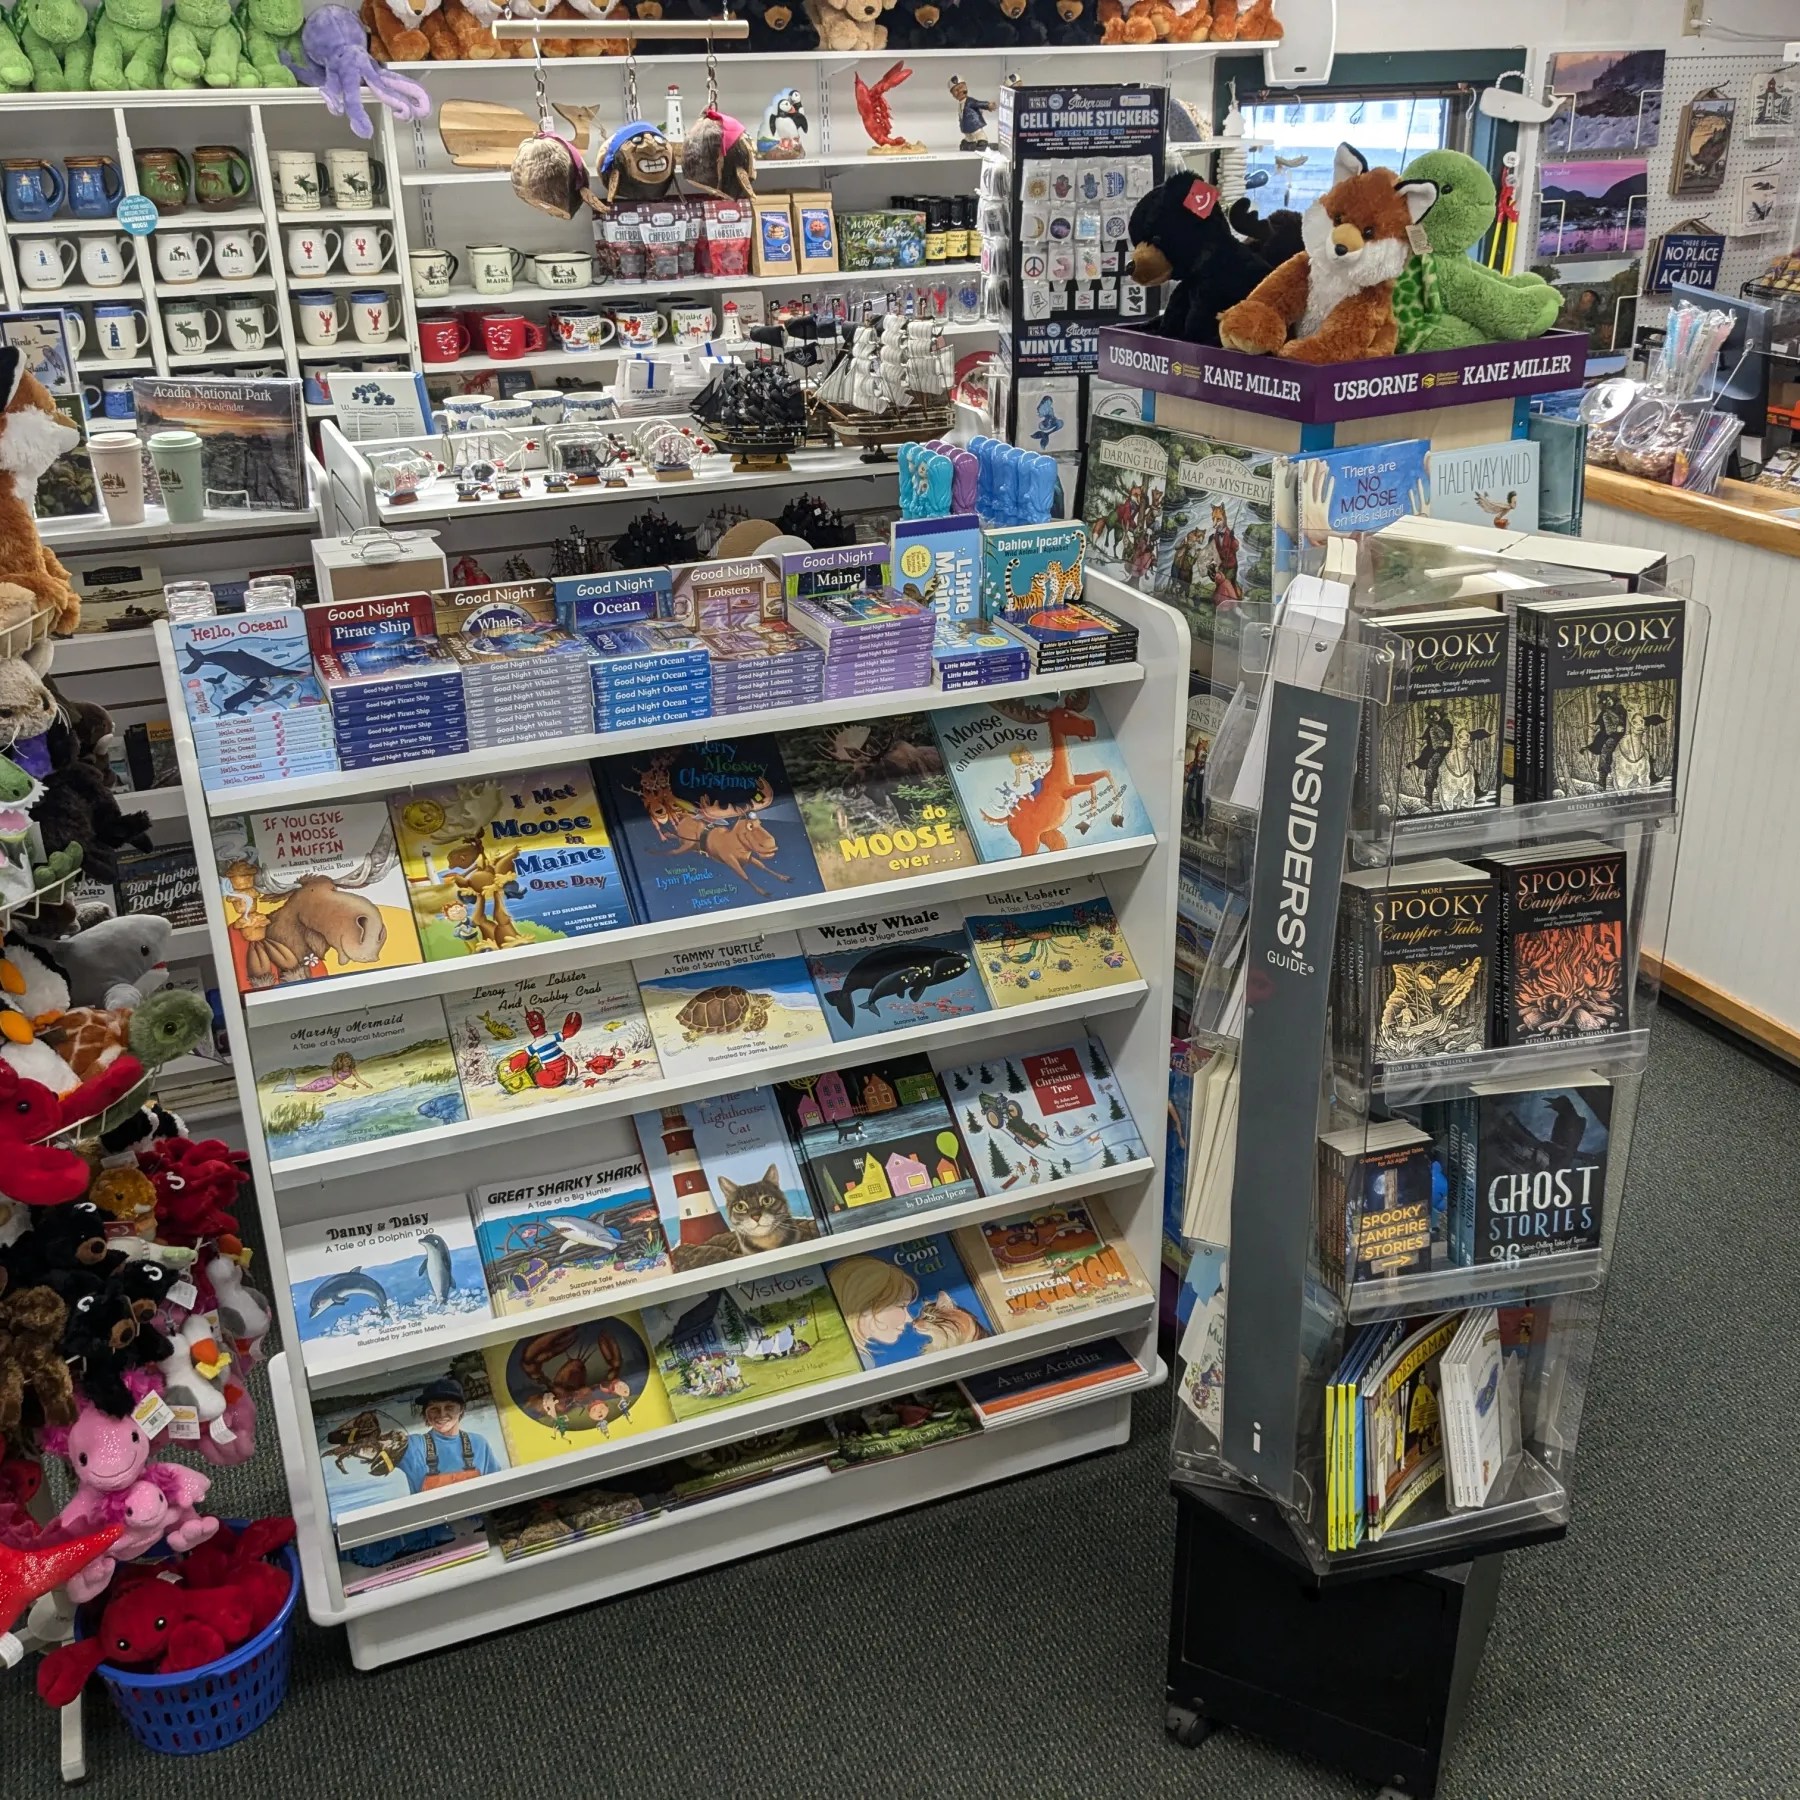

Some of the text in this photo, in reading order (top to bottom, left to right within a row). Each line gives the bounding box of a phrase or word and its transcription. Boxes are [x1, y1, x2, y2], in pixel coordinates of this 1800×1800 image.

[1020, 109, 1159, 129] CELL PHONE STICKERS
[649, 231, 681, 242] CHERRIES
[1665, 247, 1719, 261] NO PLACE
[1660, 269, 1712, 285] ACADIA
[11, 336, 31, 346] Birds
[1109, 346, 1169, 375] USBORNE
[1204, 365, 1243, 391] KANE
[1246, 373, 1301, 402] MILLER
[1334, 373, 1418, 402] USBORNE
[1462, 362, 1509, 386] KANE
[1512, 355, 1571, 379] MILLER
[153, 386, 272, 401] Acadia National Park
[184, 402, 244, 412] 2025 Calendar
[1104, 447, 1141, 467] DARING
[1202, 458, 1248, 477] HECTOR FOX
[1341, 461, 1396, 479] There are
[1438, 452, 1532, 496] HALFWAY WILD
[1182, 468, 1268, 499] MAP OF MYSTERY
[1357, 476, 1381, 492] NO
[1340, 488, 1398, 514] MOOSE
[1333, 504, 1404, 529] on this island!
[998, 534, 1071, 553] Dahlov Ipcar's
[803, 550, 874, 568] Good Night
[691, 563, 764, 582] Good Night
[817, 572, 861, 587] Maine
[455, 586, 536, 606] Good Night
[577, 577, 654, 597] Good Night
[707, 586, 751, 598] Lobsters
[935, 550, 955, 623] Maine
[955, 558, 973, 614] Little
[328, 601, 410, 621] Good Night
[593, 600, 641, 616] Ocean
[191, 616, 288, 642] Hello, Ocean!
[335, 620, 411, 640] Pirate Ship
[477, 616, 523, 629] Whales
[1557, 617, 1676, 648] SPOOKY
[1383, 632, 1501, 663] SPOOKY
[1563, 637, 1676, 663] New England
[612, 665, 632, 673] Good
[634, 660, 658, 670] Night
[660, 657, 685, 666] Ocean
[1393, 652, 1500, 677] New England
[943, 714, 1003, 750] Moose
[956, 726, 1038, 773] on the Loose
[704, 754, 768, 775] Moosey
[679, 768, 756, 790] Christmas
[511, 784, 578, 810] I Met
[262, 810, 344, 832] IF YOU GIVE
[543, 806, 558, 816] a
[922, 805, 947, 820] do
[276, 827, 338, 845] A MOOSE
[491, 814, 593, 839] Moose
[277, 839, 344, 859] A MUFFIN
[565, 833, 586, 845] in
[839, 822, 955, 862] MOOSE
[1276, 717, 1328, 960] INSIDERS'
[513, 847, 606, 877] Maine
[888, 853, 930, 871] ever
[127, 880, 152, 896] Bar
[529, 875, 608, 892] One Day
[1518, 864, 1620, 895] SPOOKY
[129, 880, 201, 913] Babylon
[985, 886, 1072, 905] Lindie Lobster
[1515, 883, 1621, 914] Campfire Tales
[1373, 894, 1489, 923] SPOOKY
[818, 909, 940, 940] Wendy Whale
[1375, 917, 1483, 945] Campfire Tales
[673, 940, 763, 965] TAMMY TURTLE
[472, 971, 587, 1000] Leroy The Lobster
[498, 982, 602, 1012] And Crabby Crab
[290, 1014, 404, 1041] Marshy Mermaid
[1040, 1056, 1059, 1066] The
[1040, 1064, 1068, 1077] Finest
[1035, 1072, 1081, 1088] Christmas
[1050, 1084, 1073, 1094] Tree
[700, 1103, 767, 1129] Lighthouse
[728, 1123, 752, 1136] Cat
[487, 1162, 644, 1205] GREAT SHARKY SHARK
[1488, 1166, 1600, 1215] GHOST
[906, 1188, 967, 1209] by Dahlov Ipcar
[326, 1212, 430, 1241] Danny & Daisy
[1362, 1204, 1423, 1230] SPOOKY
[1489, 1206, 1593, 1241] STORIES
[325, 1245, 333, 1254] A
[334, 1241, 355, 1251] Tale
[357, 1238, 368, 1248] of
[377, 1231, 414, 1244] Dolphin
[415, 1226, 435, 1236] Duo
[1354, 1218, 1427, 1245] CAMPFIRE
[1365, 1236, 1424, 1259] STORIES
[739, 1274, 814, 1302] Visitors
[1006, 1275, 1072, 1297] CRUSTACEAN
[1390, 1320, 1458, 1388] LOBSTERMAN
[997, 1377, 1012, 1388] A
[1024, 1371, 1042, 1380] for
[1045, 1352, 1101, 1375] Acadia
